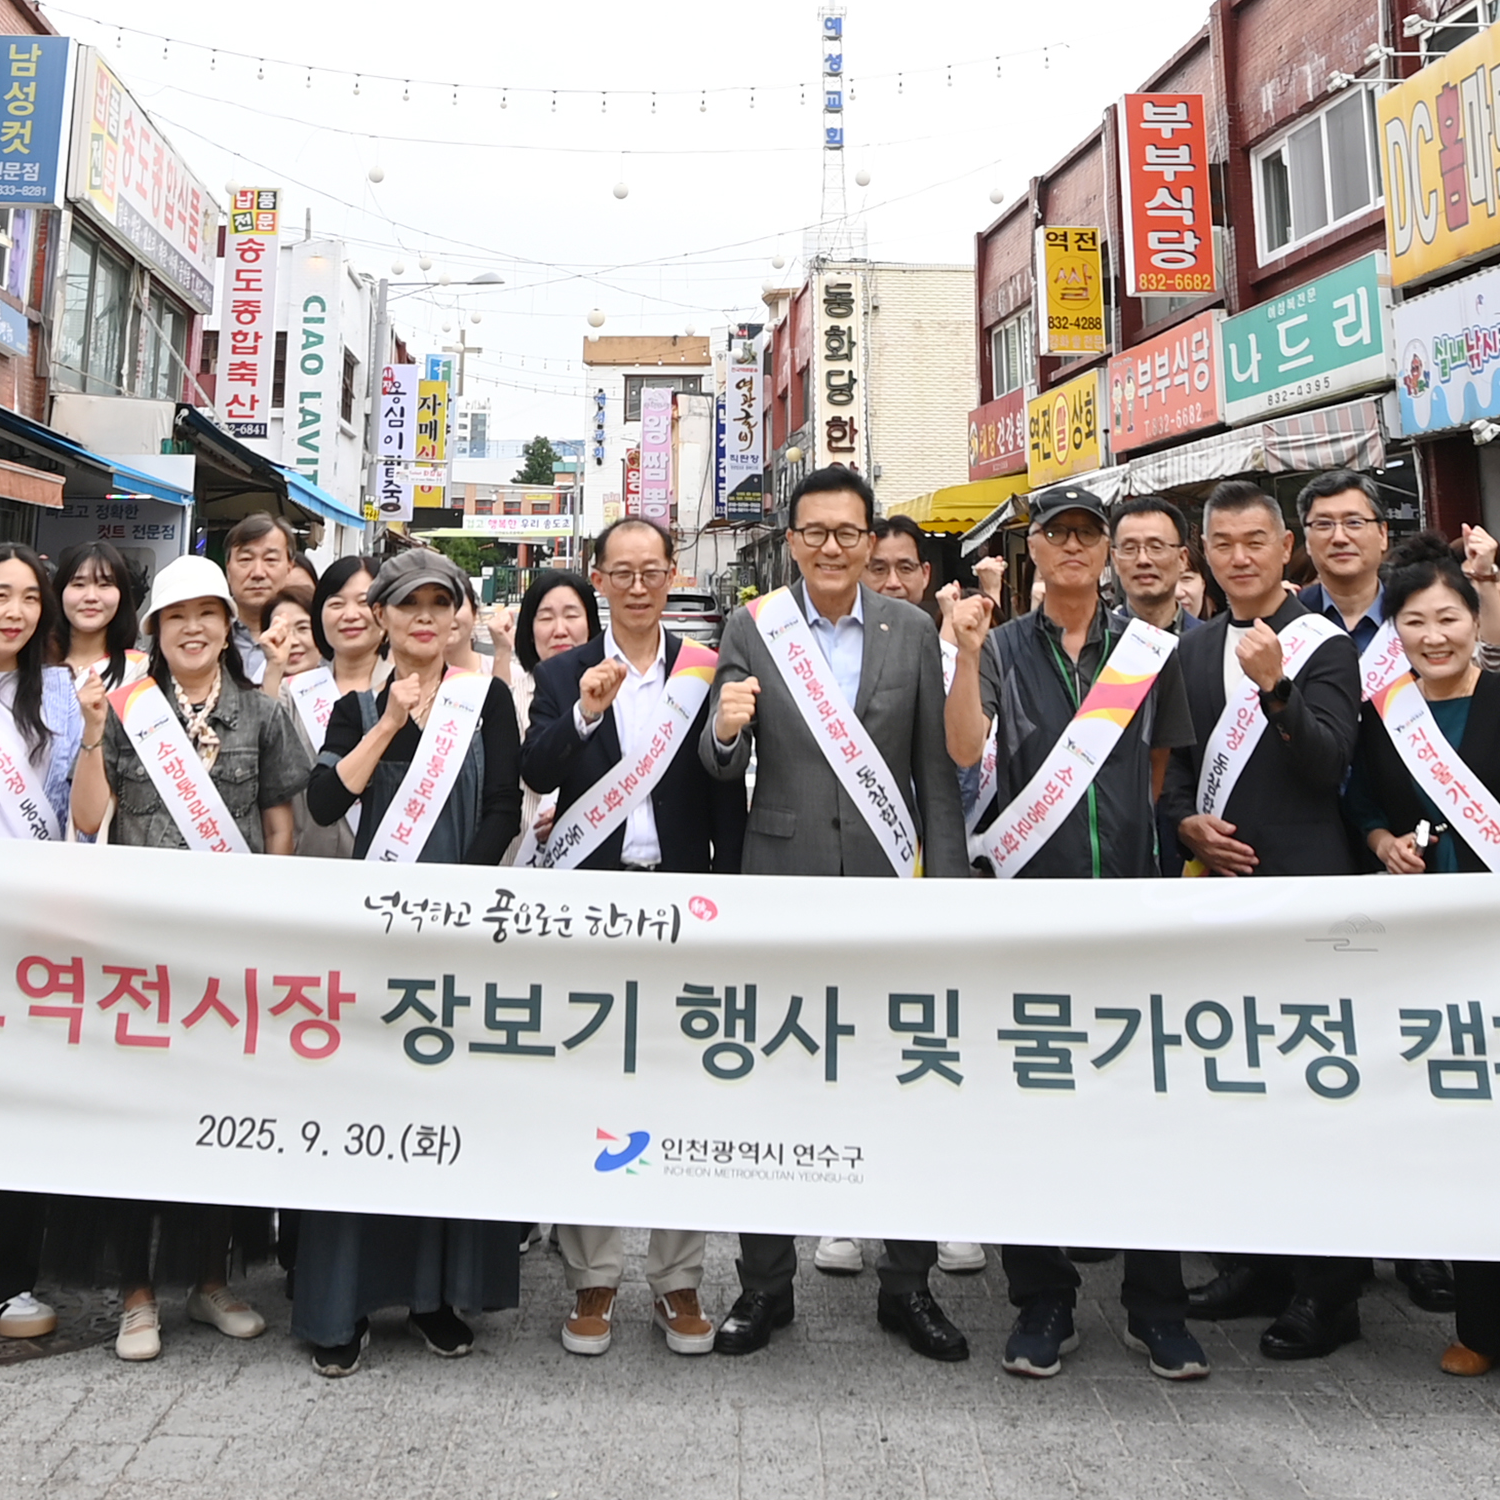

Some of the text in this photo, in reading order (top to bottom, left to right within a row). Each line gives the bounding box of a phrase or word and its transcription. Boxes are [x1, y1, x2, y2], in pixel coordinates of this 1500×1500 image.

[1, 43, 42, 155] 남성컷
[1140, 102, 1200, 270] 부부식당
[1046, 231, 1097, 252] 역전
[1139, 273, 1211, 290] 832-6682
[226, 237, 266, 420] 송도종합축산
[300, 295, 327, 376] CIAO
[1048, 316, 1102, 330] 832-4288
[1229, 286, 1371, 383] 나드리
[1137, 328, 1209, 410] 부부식당
[96, 505, 139, 520] 정확한
[132, 525, 174, 539] 전문점
[389, 718, 456, 845] 소방통로확보
[785, 639, 916, 863] 소방통로확보 동참합시다
[585, 899, 682, 944] 한가위
[381, 973, 640, 1075] 장보기
[677, 980, 855, 1083] 행사
[886, 987, 965, 1087] 및
[998, 991, 1362, 1102] 물가안정
[195, 1114, 462, 1168] 2025. 9. 30.(화)
[660, 1135, 865, 1172] 인천광역시 연수구
[663, 1166, 865, 1185] INCHEON METROPOLITAN YEONSU-GU
